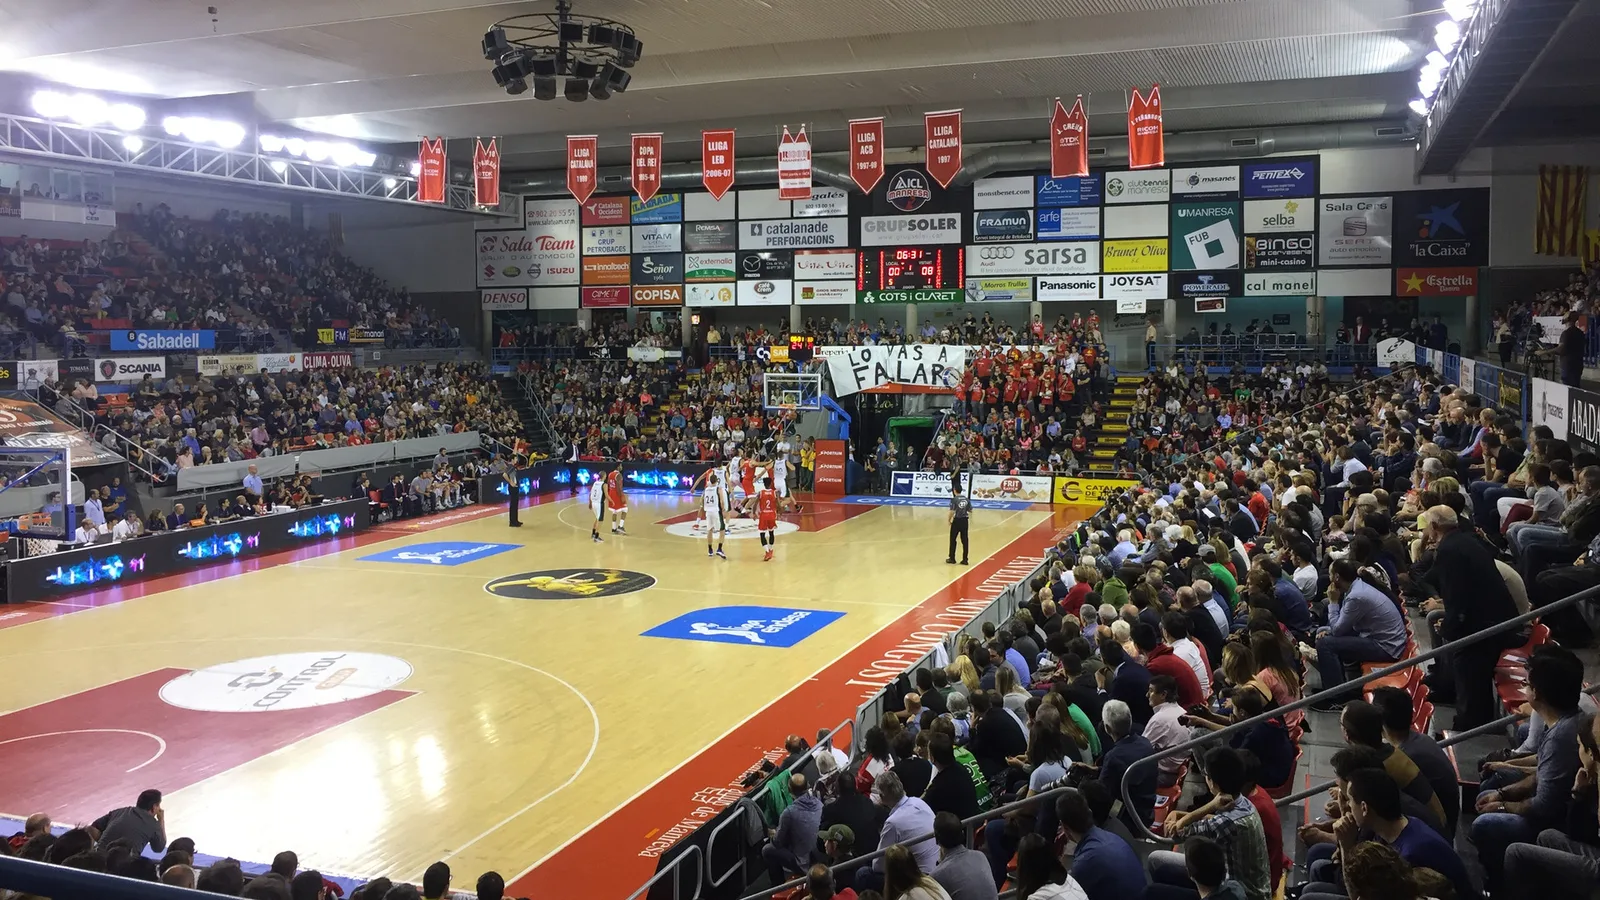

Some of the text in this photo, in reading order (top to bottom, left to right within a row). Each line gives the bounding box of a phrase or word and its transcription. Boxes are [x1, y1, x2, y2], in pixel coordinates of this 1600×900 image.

[933, 125, 953, 136] LLIGA
[1063, 123, 1083, 133] CREUS
[857, 132, 876, 143] LLIGA
[929, 137, 959, 149] CATALANA
[639, 146, 654, 156] COPA
[708, 141, 728, 151] LLIGA
[860, 145, 874, 155] ACB
[574, 148, 590, 158] LLIGA
[570, 159, 594, 169] CATALANA
[637, 157, 657, 167] DEL REI
[711, 155, 725, 165] LEB
[937, 155, 951, 164] 1997
[705, 169, 731, 178] 2006-07
[1252, 169, 1292, 180] PENTEX
[888, 188, 929, 200] MANRESA
[1326, 202, 1388, 212] Sala Cars
[980, 217, 1026, 226] FRAMUN
[1039, 210, 1060, 223] arfe
[1263, 213, 1295, 226] selba
[766, 221, 828, 235] catalanade
[864, 217, 957, 232] GRUPSOLER
[642, 233, 672, 241] VITAM
[766, 235, 835, 246] PERFORACIONS
[1188, 230, 1210, 246] FUB
[500, 235, 576, 252] Sala Team
[587, 245, 627, 254] PETROBAGES
[896, 250, 923, 260] 06:31
[1105, 245, 1167, 257] Brunet Oliva
[1024, 247, 1087, 265] sarsa
[642, 261, 674, 274] Señor
[1260, 258, 1306, 266] mini-casino
[547, 267, 575, 275] ISUZU
[888, 267, 900, 276] 00
[921, 266, 933, 276] 08
[1040, 279, 1097, 290] Panasonic
[1110, 276, 1162, 287] JOYSAT
[1247, 278, 1314, 291] cal manel
[1426, 274, 1473, 287] Estrella
[1183, 283, 1230, 291] POWERADE
[483, 292, 526, 304] DENSO
[634, 289, 680, 301] COPISA
[879, 292, 907, 301] COTS
[915, 291, 957, 301] CLARET
[137, 333, 200, 349] Sabadell
[849, 344, 948, 366] LO VAS A
[119, 363, 162, 374] SCANIA
[853, 361, 945, 390] FALAR
[705, 495, 715, 504] 24
[766, 500, 770, 508] 2
[761, 610, 812, 634] endesa
[253, 653, 347, 708] CONTROL
[638, 806, 720, 858] de Manresa
